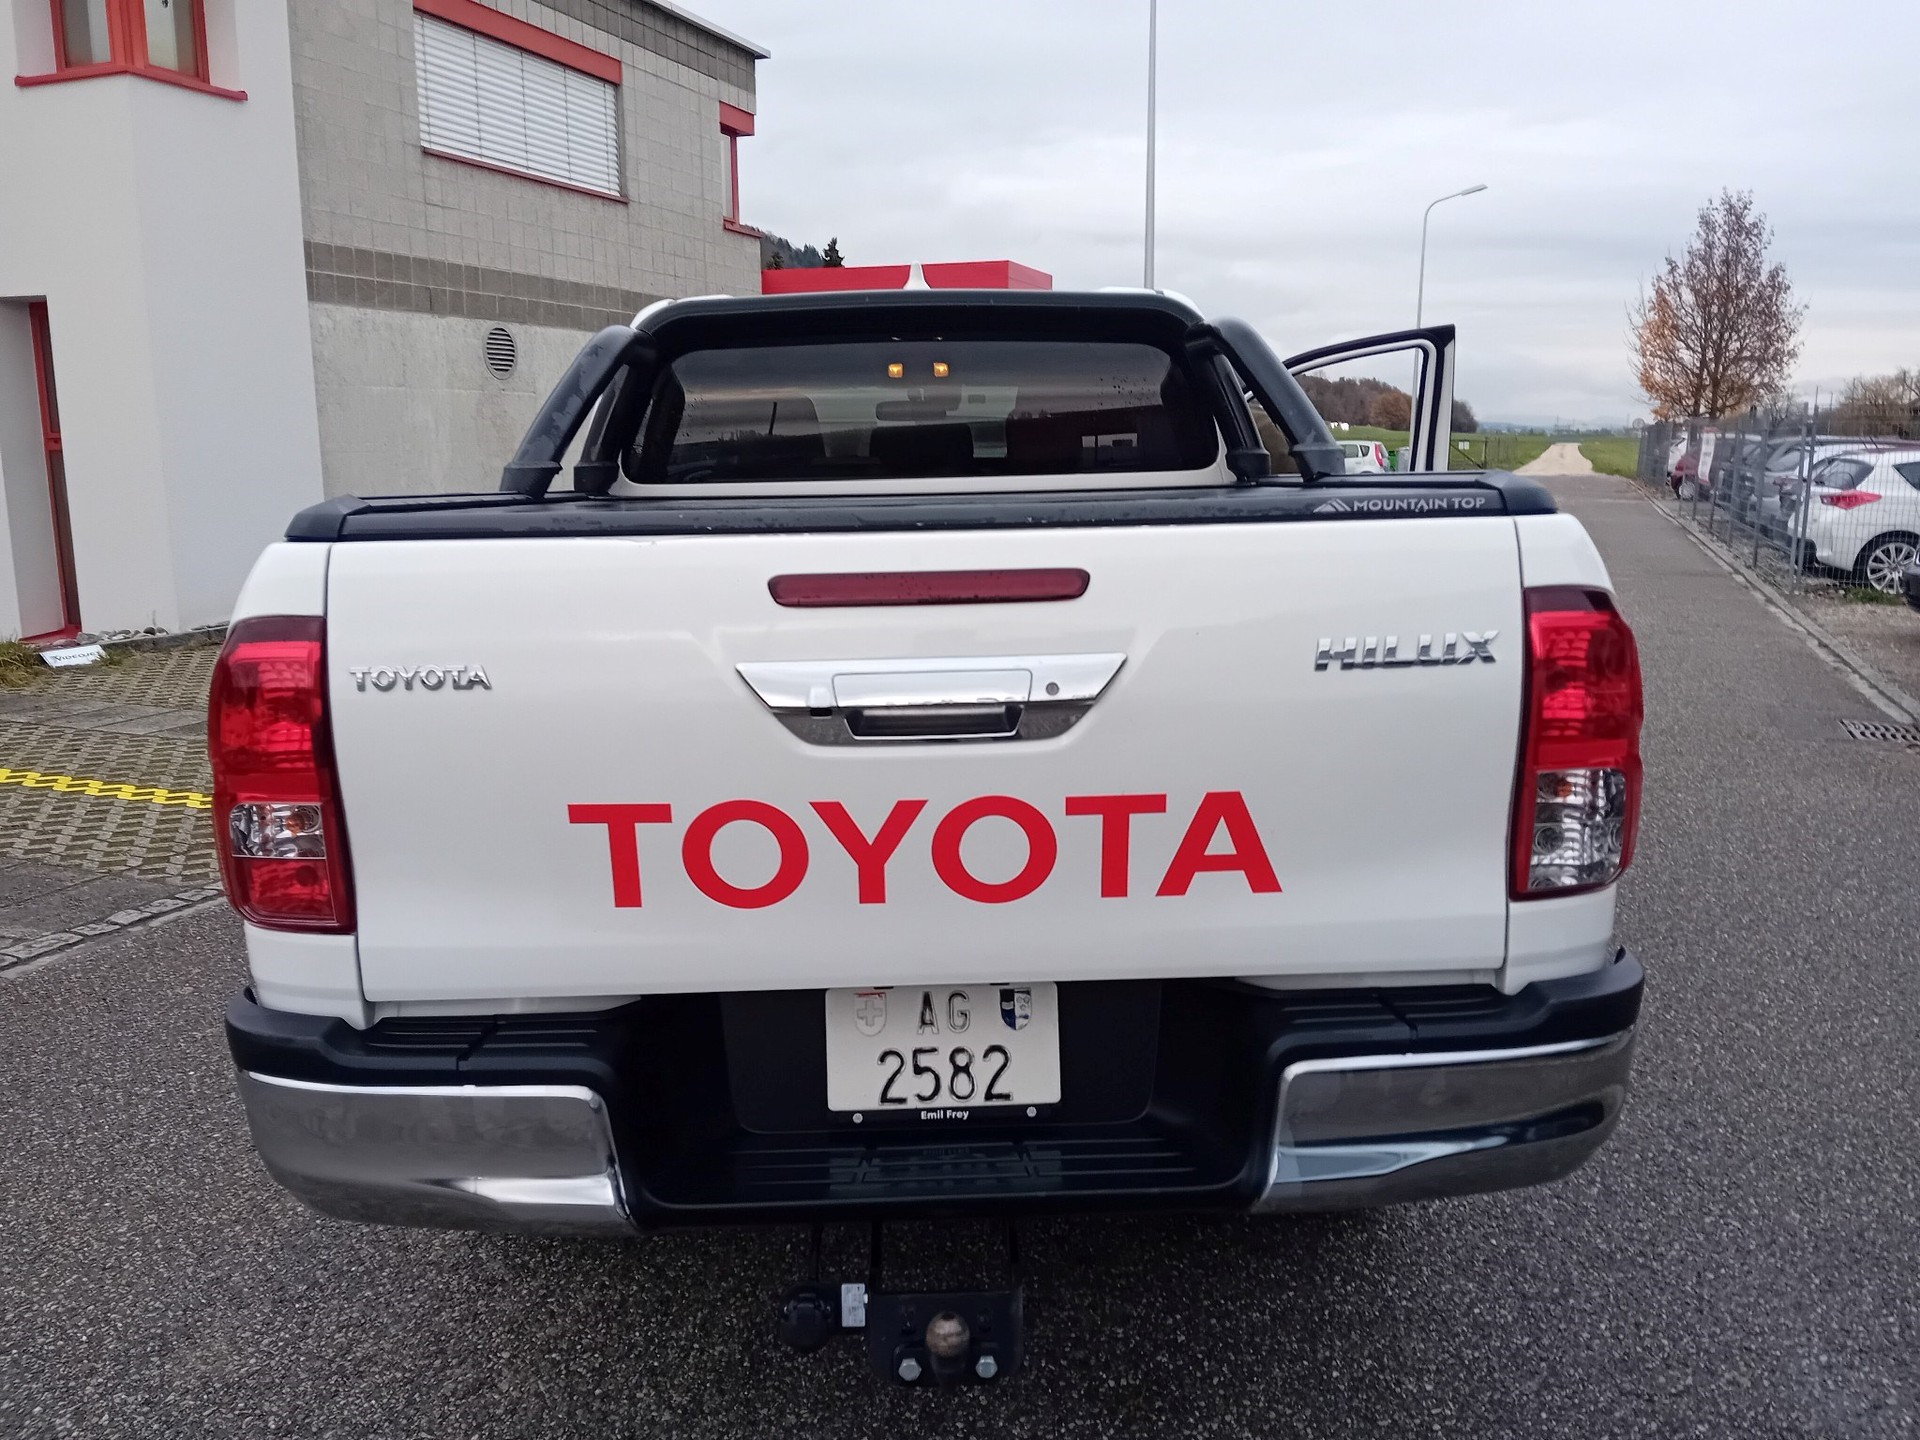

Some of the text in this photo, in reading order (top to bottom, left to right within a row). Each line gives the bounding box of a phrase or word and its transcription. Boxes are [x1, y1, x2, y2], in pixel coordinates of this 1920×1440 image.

[1353, 497, 1486, 512] MOUNTAIN TOP
[1315, 630, 1500, 671] HILUX
[349, 664, 492, 692] TOYOTA
[567, 791, 1283, 910] TOYOTA
[917, 990, 971, 1034] AG
[877, 1045, 1014, 1105] 2582
[921, 1109, 969, 1120] Emil Frey
